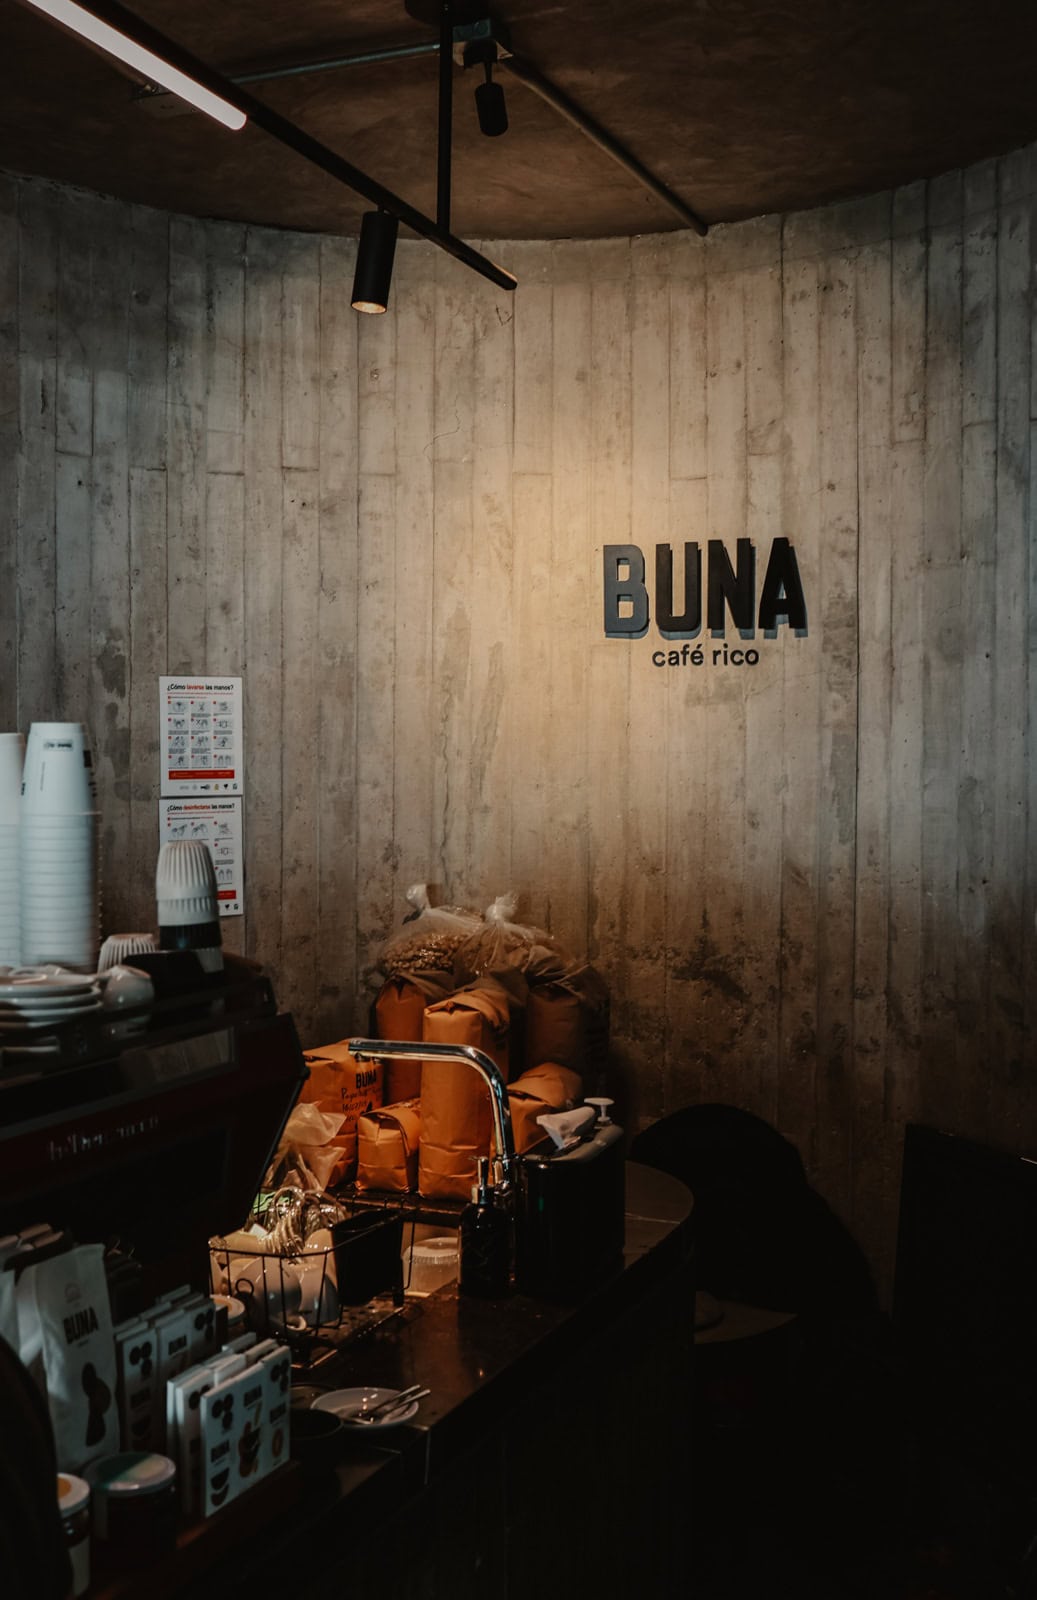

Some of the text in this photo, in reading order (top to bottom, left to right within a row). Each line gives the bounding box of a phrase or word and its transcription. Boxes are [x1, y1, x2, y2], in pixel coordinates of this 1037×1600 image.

[603, 537, 807, 636] BUNA
[652, 643, 760, 667] café rico
[63, 1306, 99, 1345] BUNA
